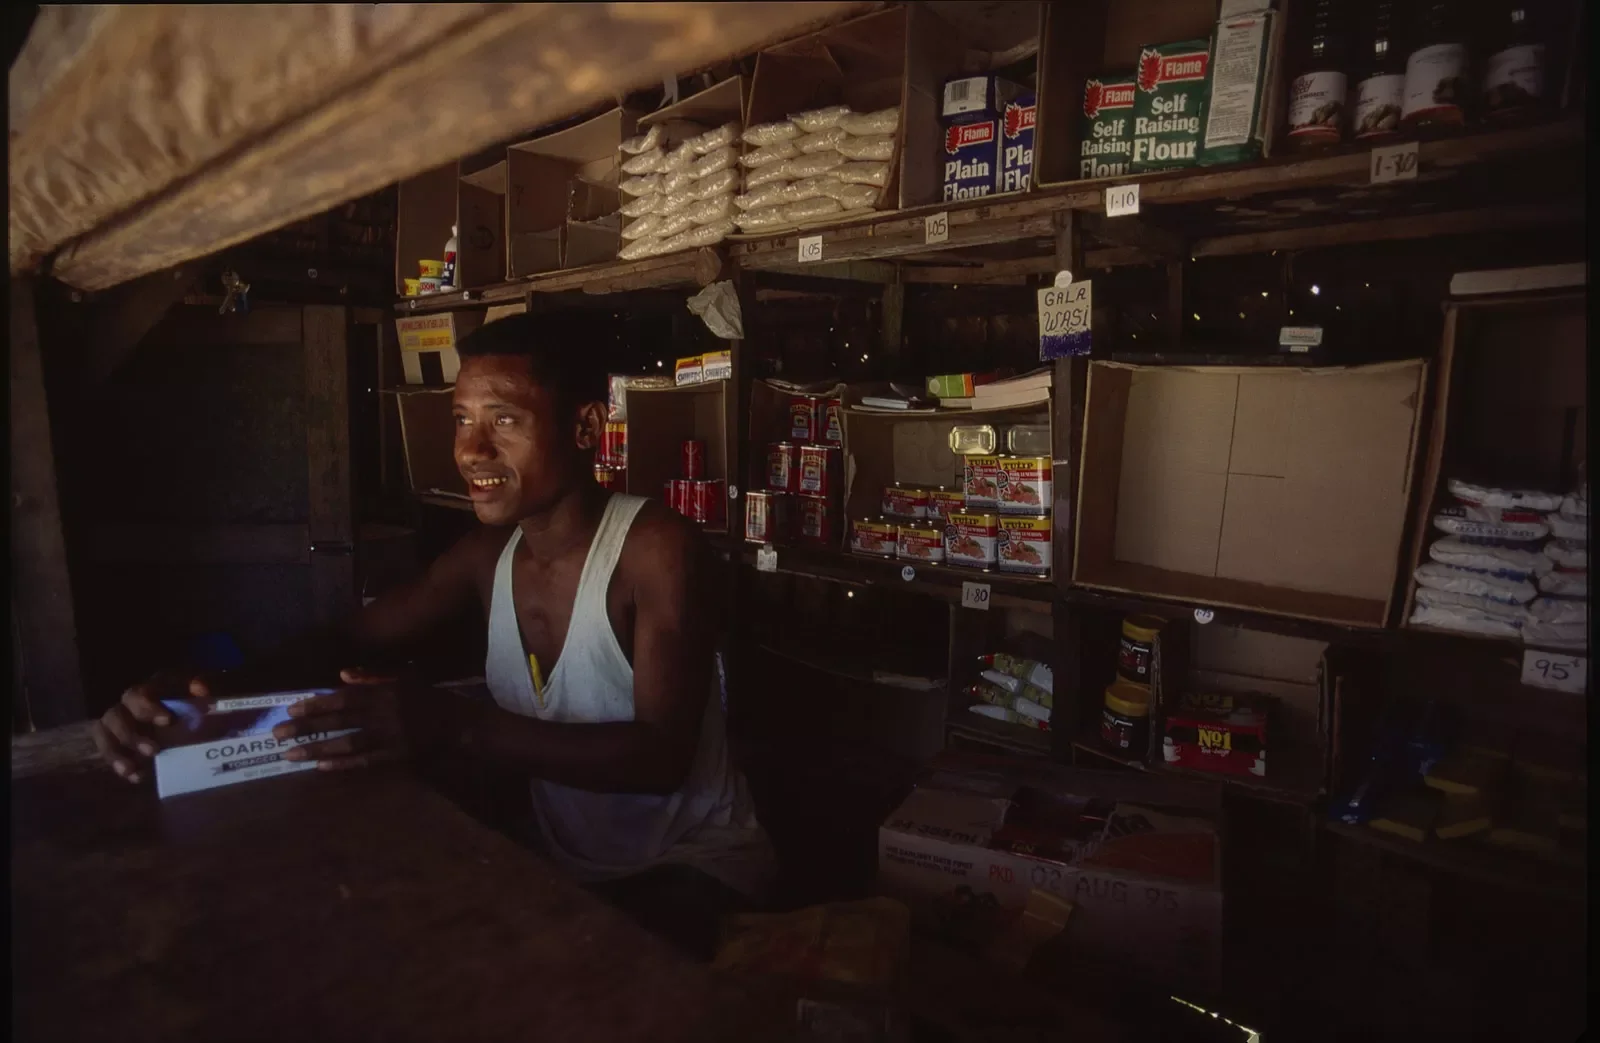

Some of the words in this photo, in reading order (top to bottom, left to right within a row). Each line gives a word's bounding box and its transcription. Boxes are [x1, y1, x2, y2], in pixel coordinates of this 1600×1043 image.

[1164, 60, 1202, 77] Flame
[1150, 93, 1188, 115] Self
[963, 126, 990, 141] Flame
[1093, 119, 1125, 138] Self
[1135, 113, 1200, 135] Raising
[1005, 144, 1033, 169] Pla
[1132, 136, 1197, 162] Flour
[944, 157, 990, 182] Plain
[943, 182, 990, 203] Flour
[1003, 460, 1034, 470] TULIP
[1003, 521, 1034, 529] TULIP
[223, 698, 273, 709] TOBACCO
[228, 754, 278, 769] TOBACCO
[1075, 875, 1128, 905] AUG
